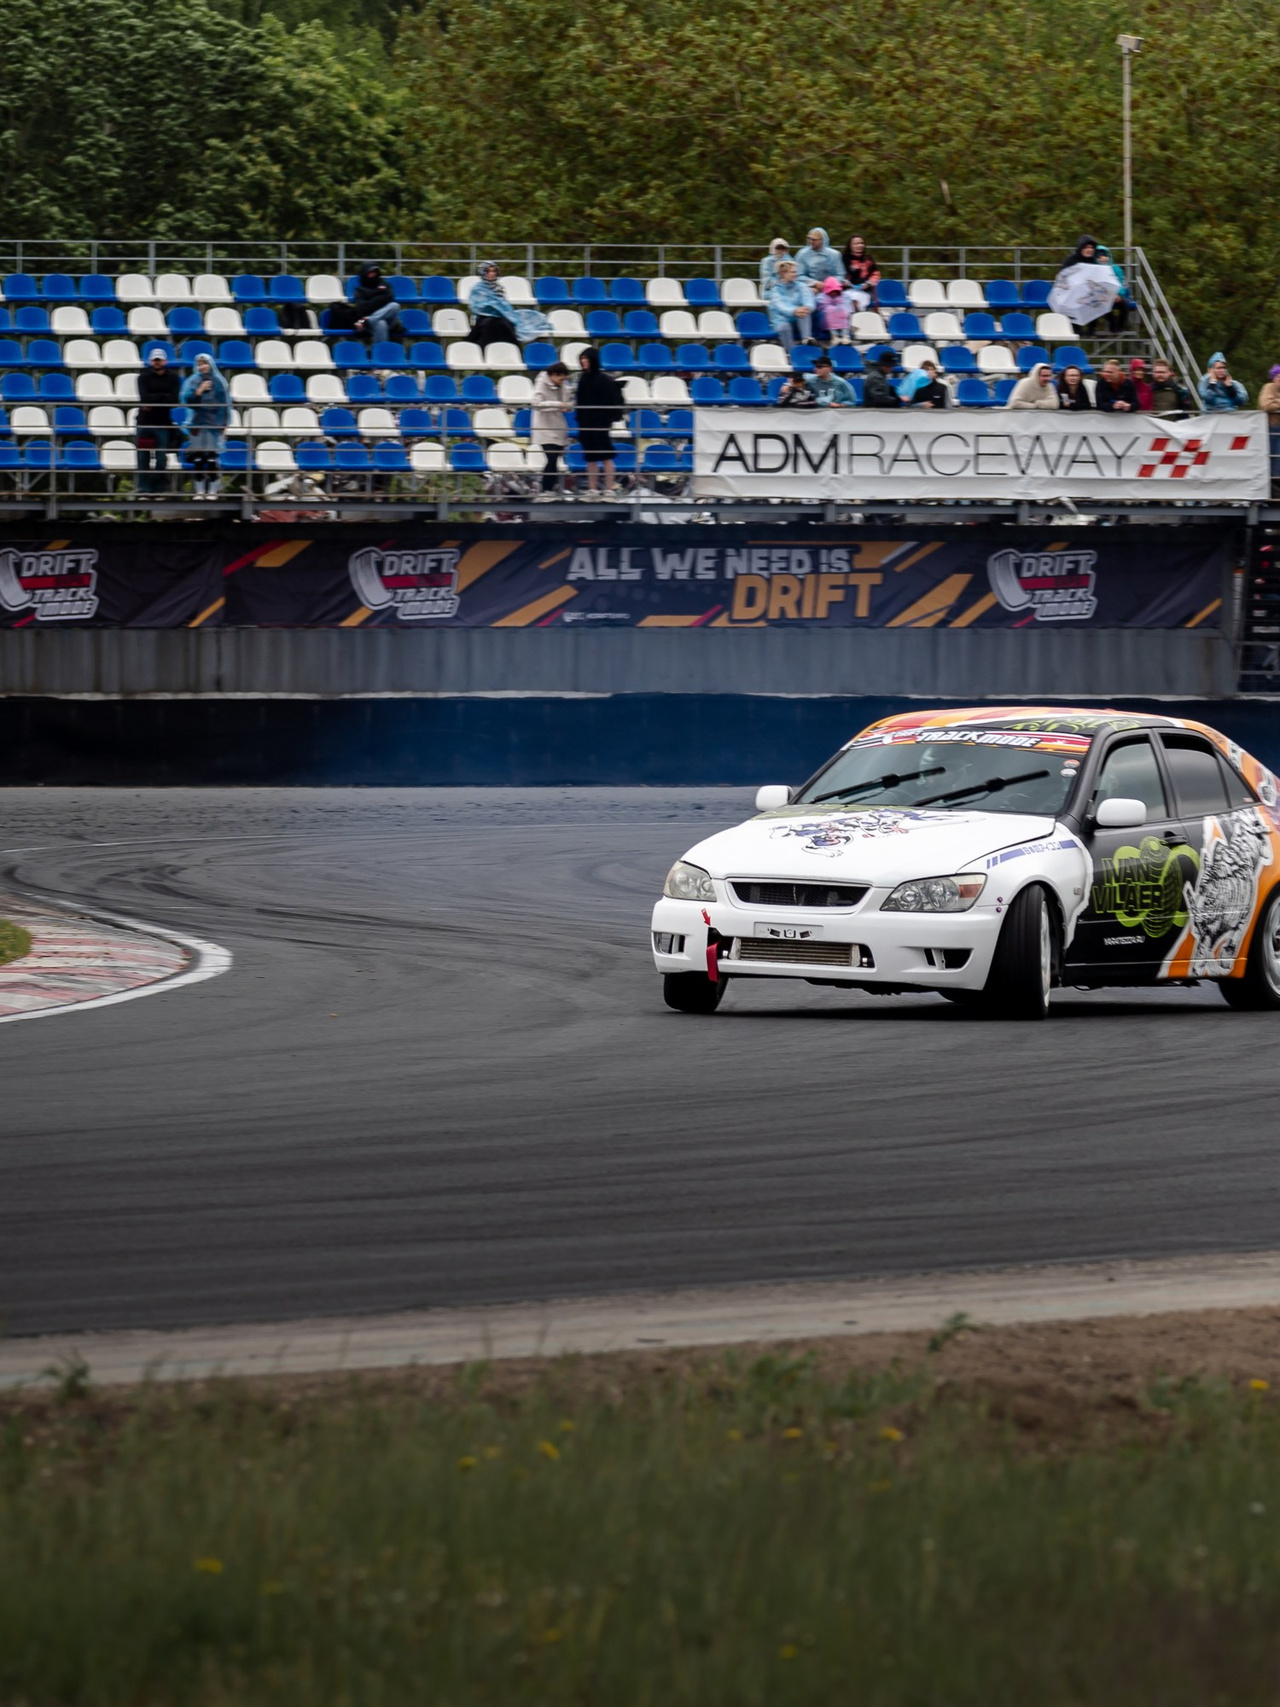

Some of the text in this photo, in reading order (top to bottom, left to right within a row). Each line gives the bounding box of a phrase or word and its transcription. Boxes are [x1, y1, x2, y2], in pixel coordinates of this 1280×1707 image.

[21, 554, 93, 577] DRIFT
[383, 553, 455, 576] DRIFT
[566, 547, 852, 580] ALL WE NEED IS
[1021, 555, 1092, 578] DRIFT
[731, 572, 883, 620] DRIFT
